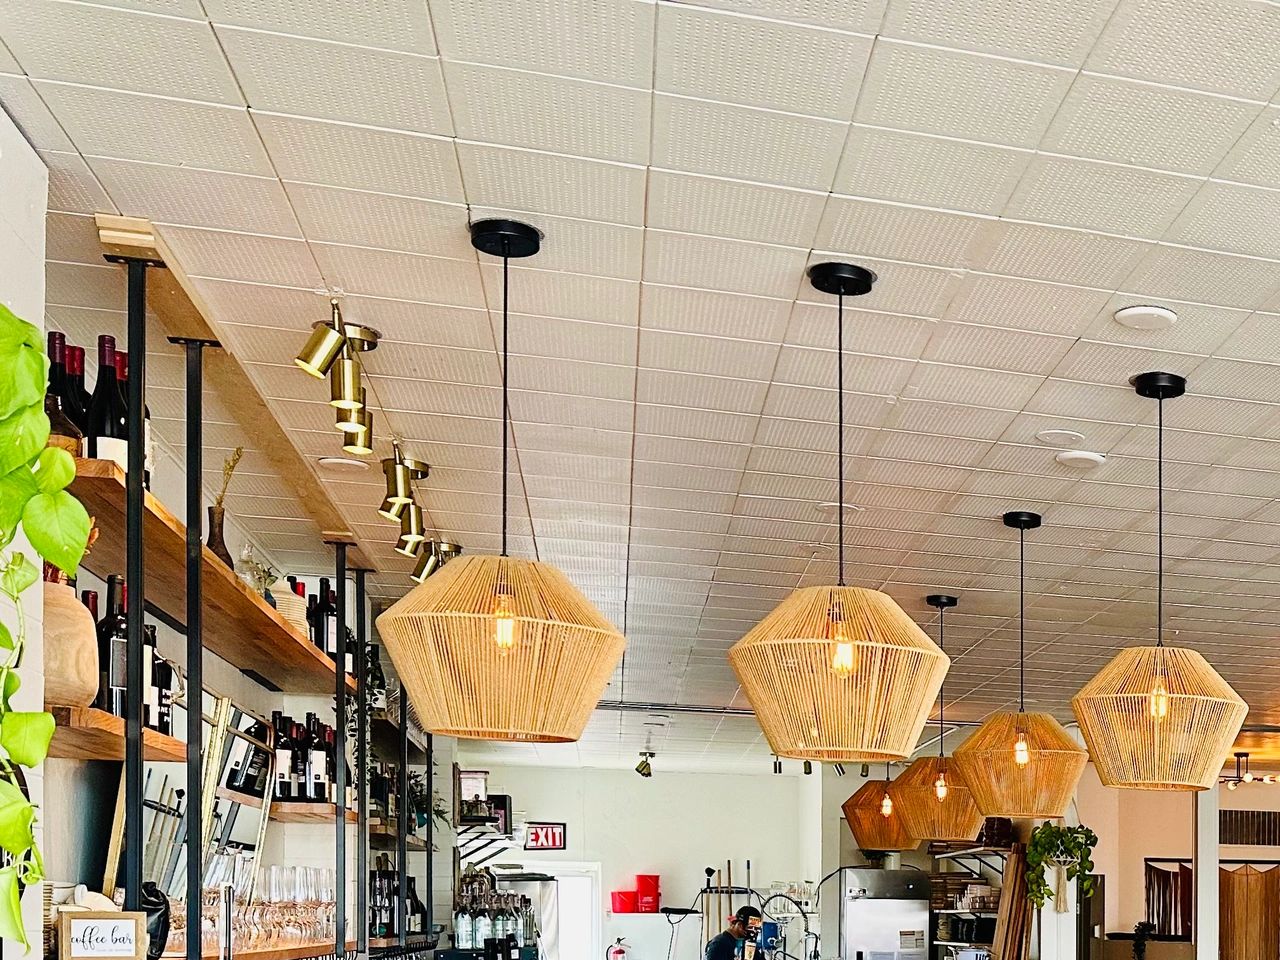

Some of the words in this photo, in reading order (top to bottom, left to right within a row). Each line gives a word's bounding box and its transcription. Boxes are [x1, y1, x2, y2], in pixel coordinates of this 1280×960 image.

[528, 827, 562, 847] EXIT
[71, 925, 107, 950] coffee
[112, 925, 133, 944] bar
